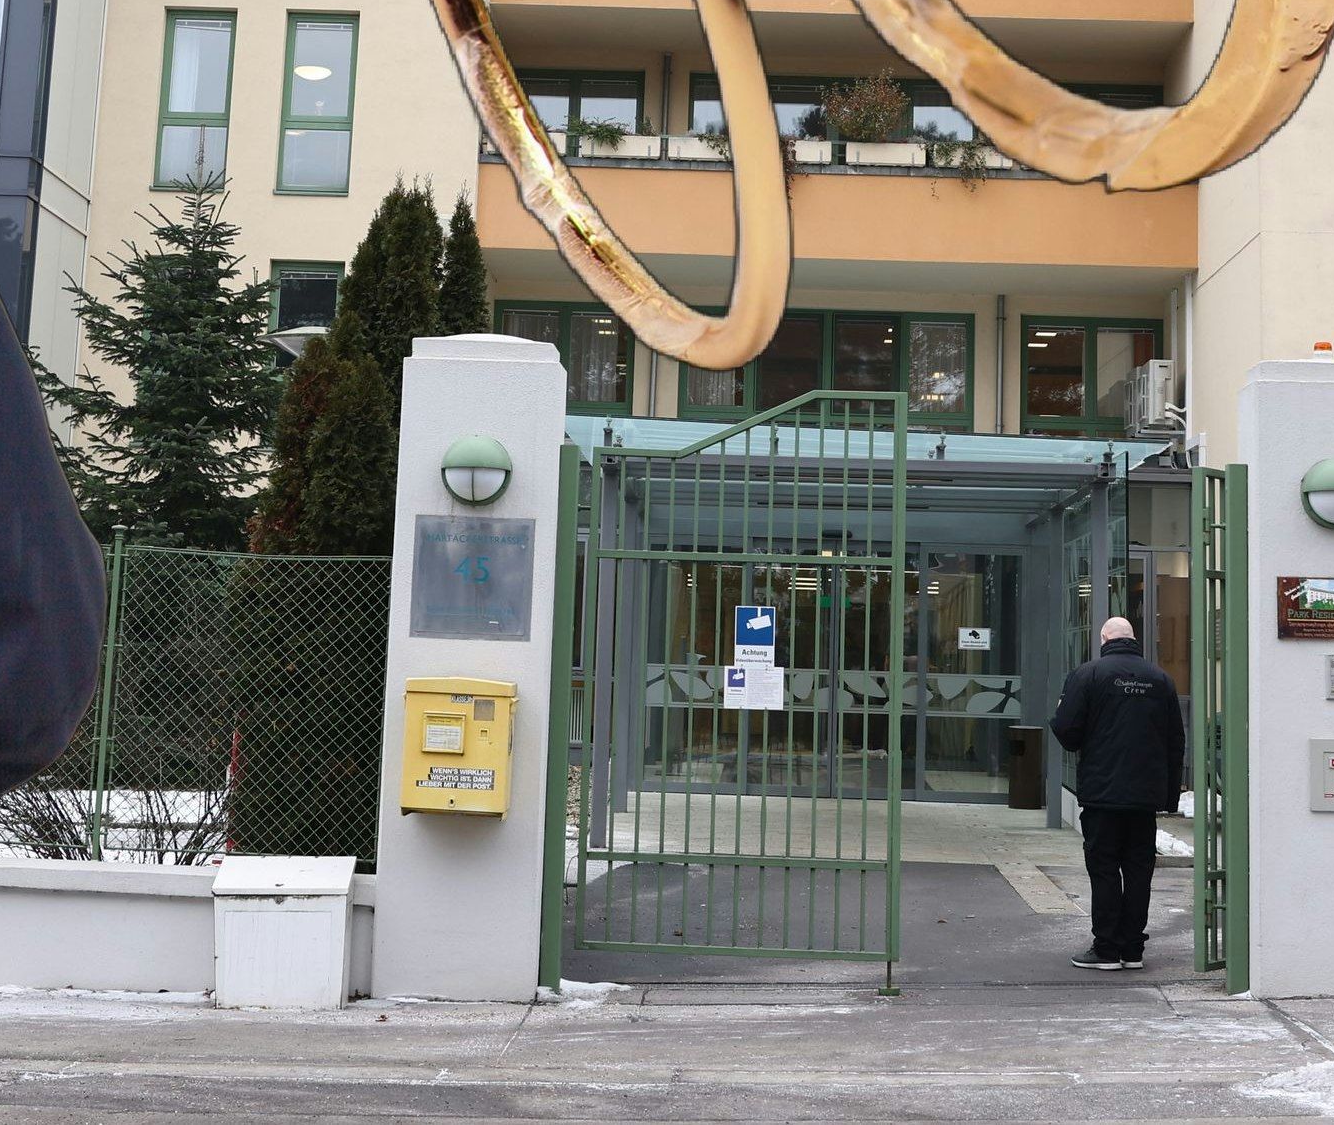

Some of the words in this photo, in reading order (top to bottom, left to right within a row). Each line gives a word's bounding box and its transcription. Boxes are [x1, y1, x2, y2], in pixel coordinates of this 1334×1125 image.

[453, 555, 492, 584] 45
[742, 649, 768, 657] Achtung
[1124, 686, 1146, 694] Crew
[432, 767, 458, 775] WENN'S
[430, 774, 459, 782] WICHTIG
